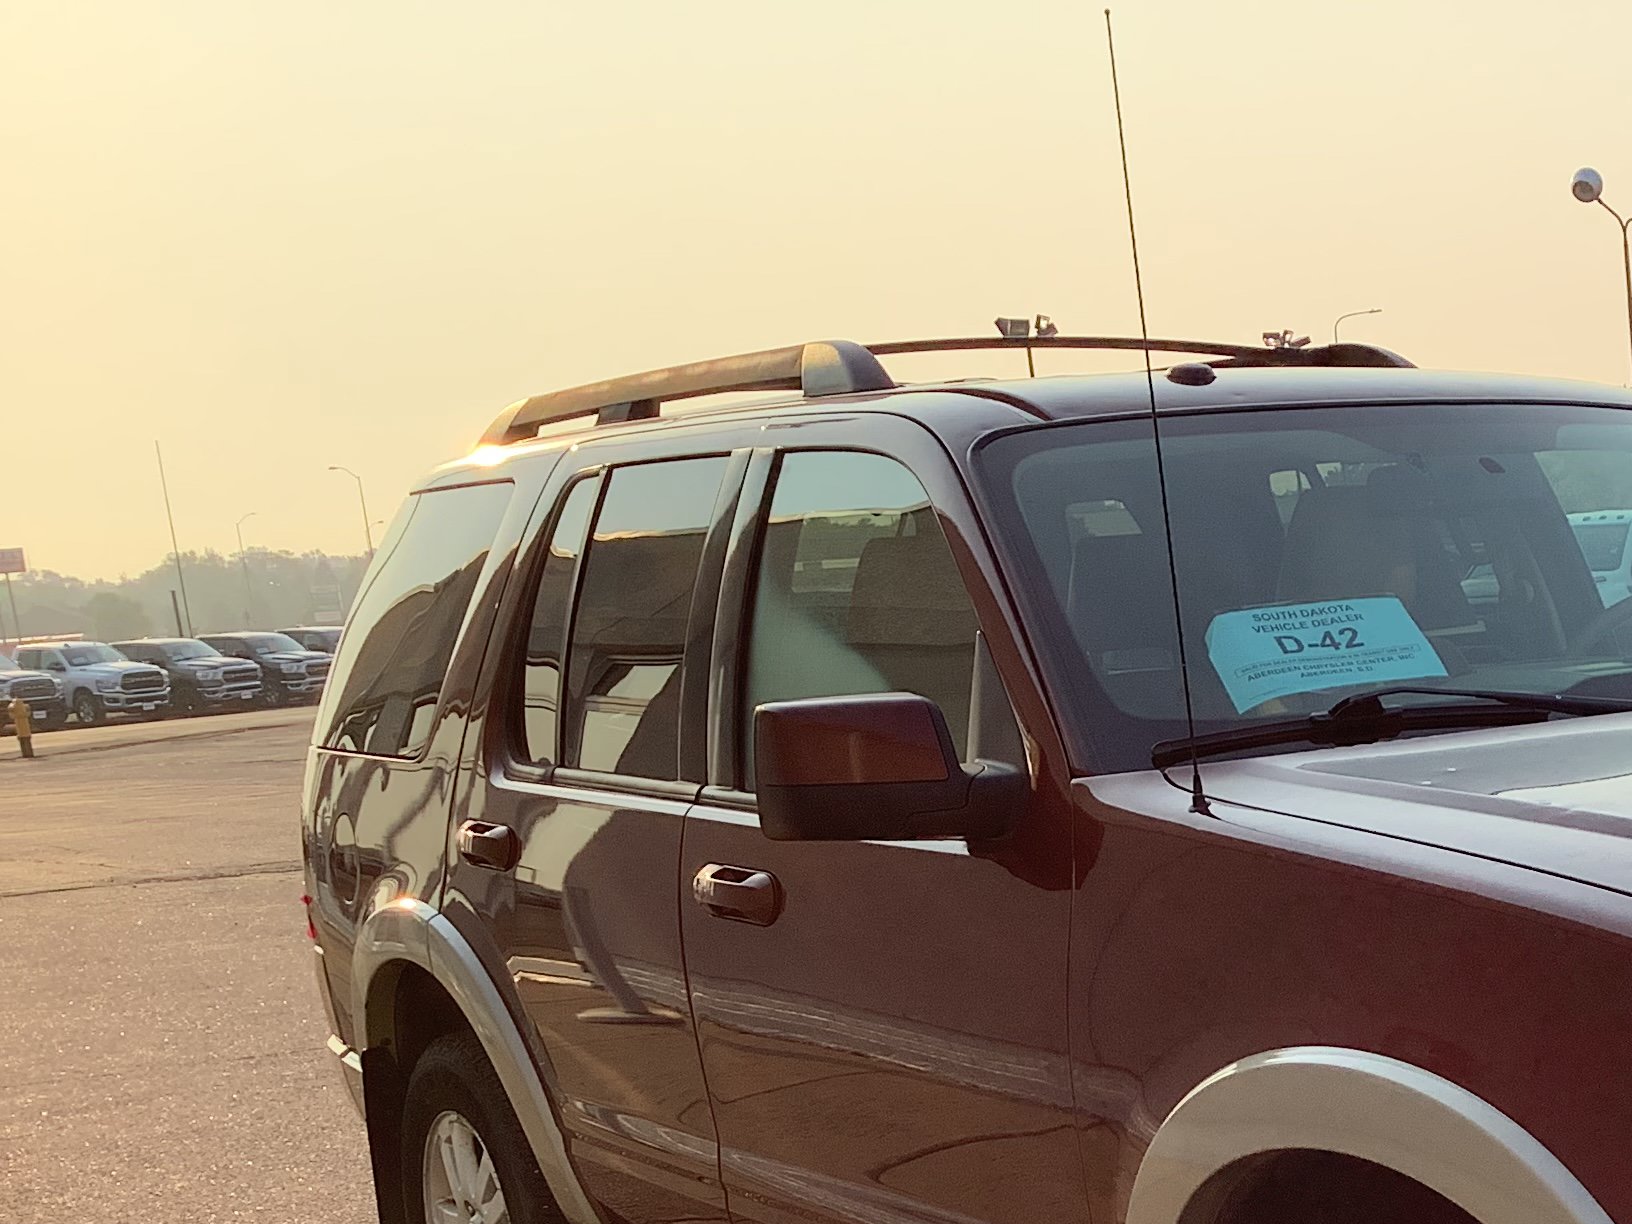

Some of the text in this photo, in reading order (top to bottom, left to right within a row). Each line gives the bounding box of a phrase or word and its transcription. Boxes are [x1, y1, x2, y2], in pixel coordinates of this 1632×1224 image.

[1251, 613, 1365, 634] VEHICLE DEALER
[1252, 604, 1355, 622] SOUTH DAKOTA
[1273, 627, 1365, 655] D-42
[1247, 665, 1302, 682] ABERDEEN
[1302, 660, 1354, 671] CHRYSLER
